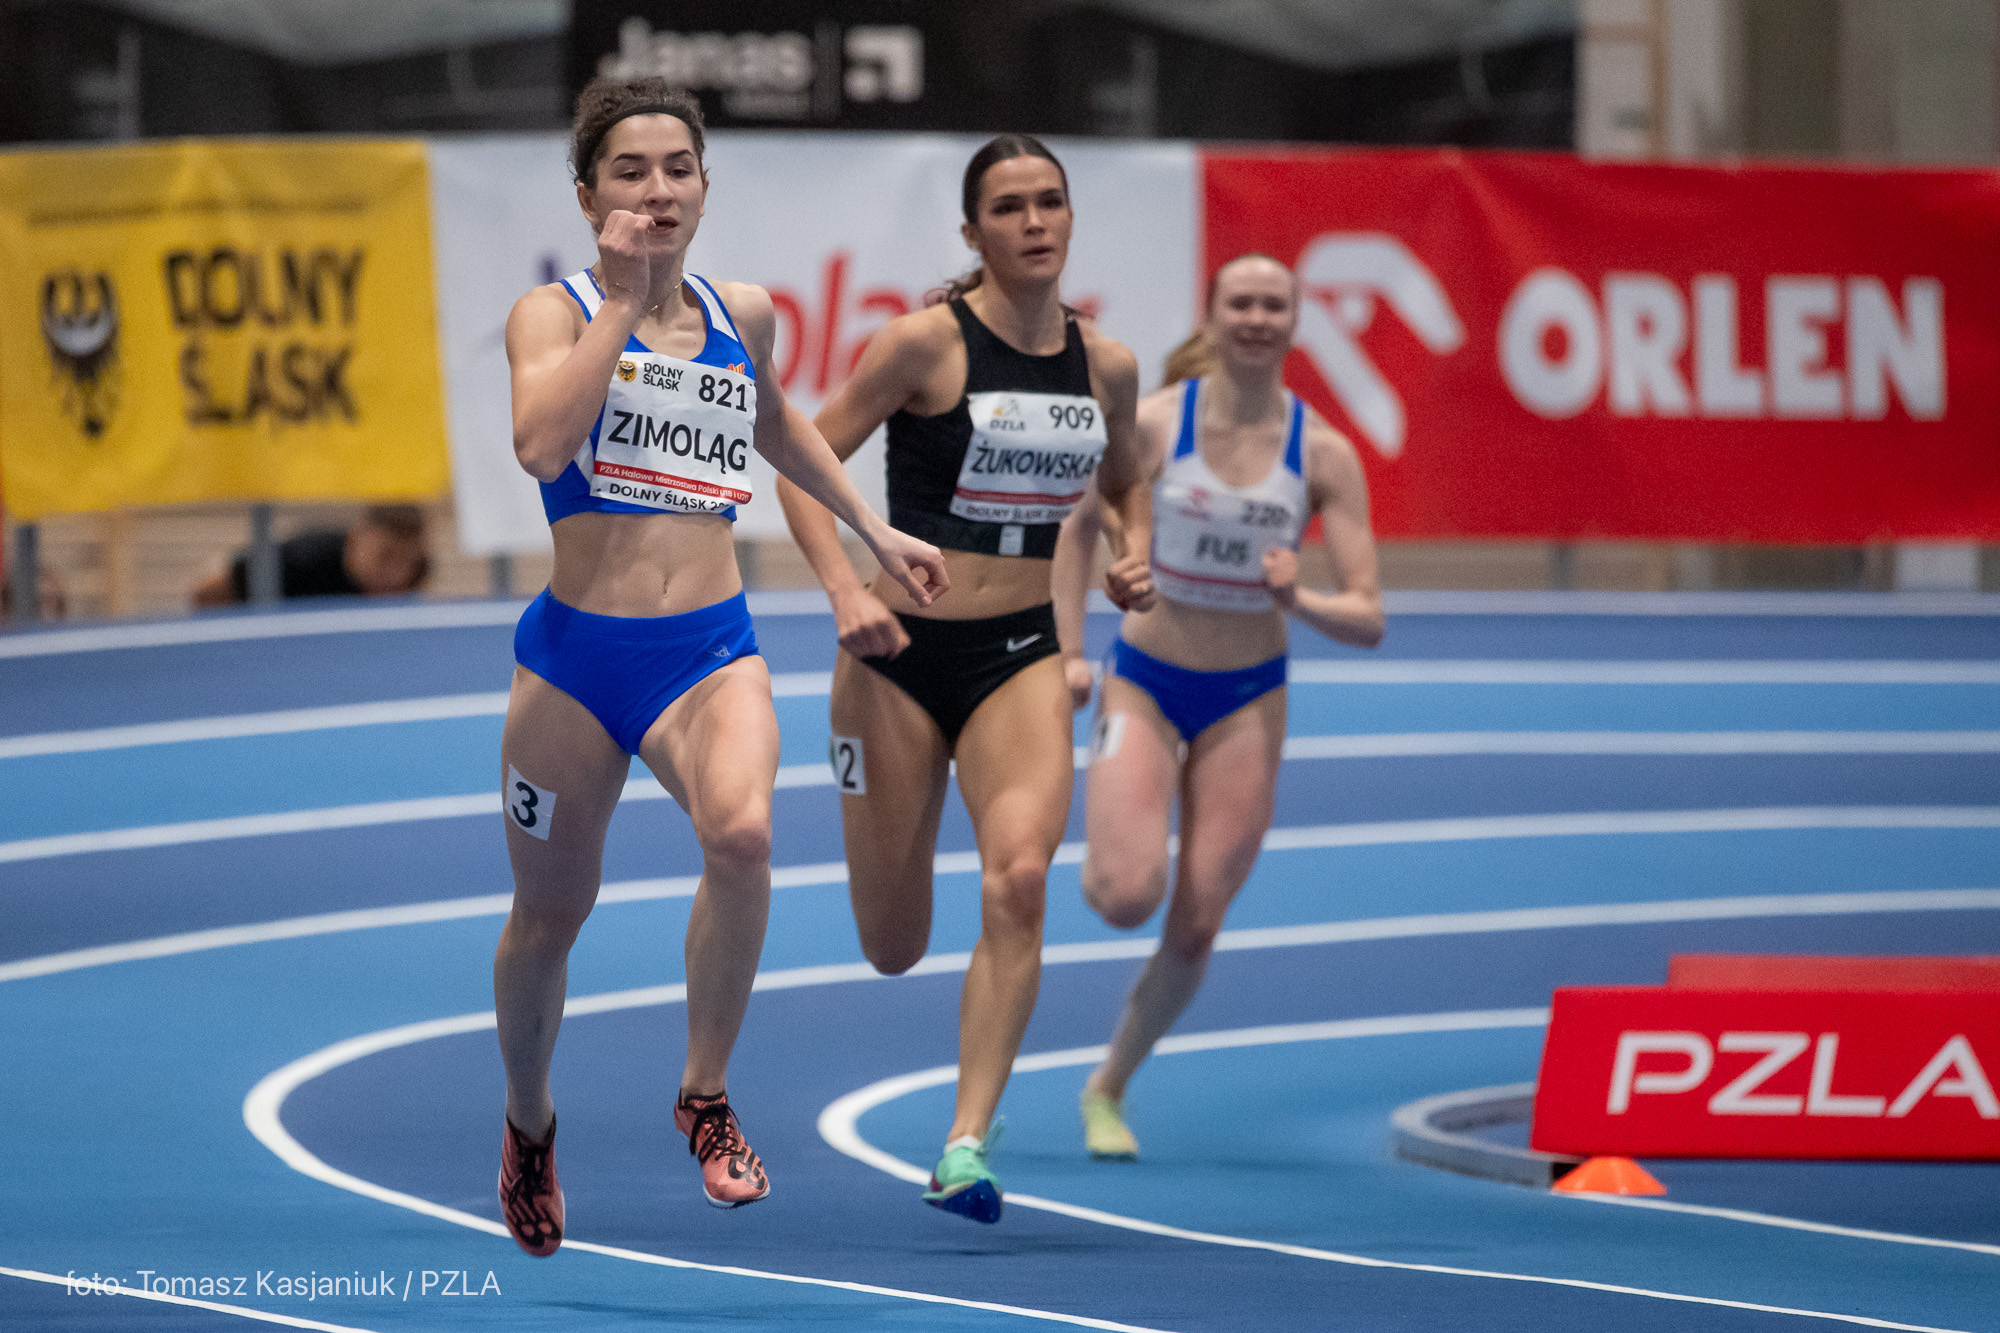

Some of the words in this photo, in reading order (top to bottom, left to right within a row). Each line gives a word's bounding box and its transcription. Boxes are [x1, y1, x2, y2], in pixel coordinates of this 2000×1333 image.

[160, 244, 368, 332] DOLNY
[1497, 265, 1948, 422] ORLEN
[642, 374, 680, 392] ŚLĄSK
[643, 362, 684, 381] DOLNY
[698, 374, 748, 413] 821
[1050, 405, 1094, 431] 909
[607, 409, 748, 475] ZIMOLĄG
[599, 465, 619, 476] PZLA
[621, 469, 654, 482] Halowe
[655, 475, 698, 491] Mistrzostwa
[697, 484, 719, 496] Polski
[609, 483, 661, 502] DOLNY
[664, 490, 707, 511] ŚLĄSK
[1196, 533, 1249, 567] FUS
[839, 743, 856, 789] 2
[512, 781, 538, 828] 3
[1606, 1031, 2000, 1119] PZLA
